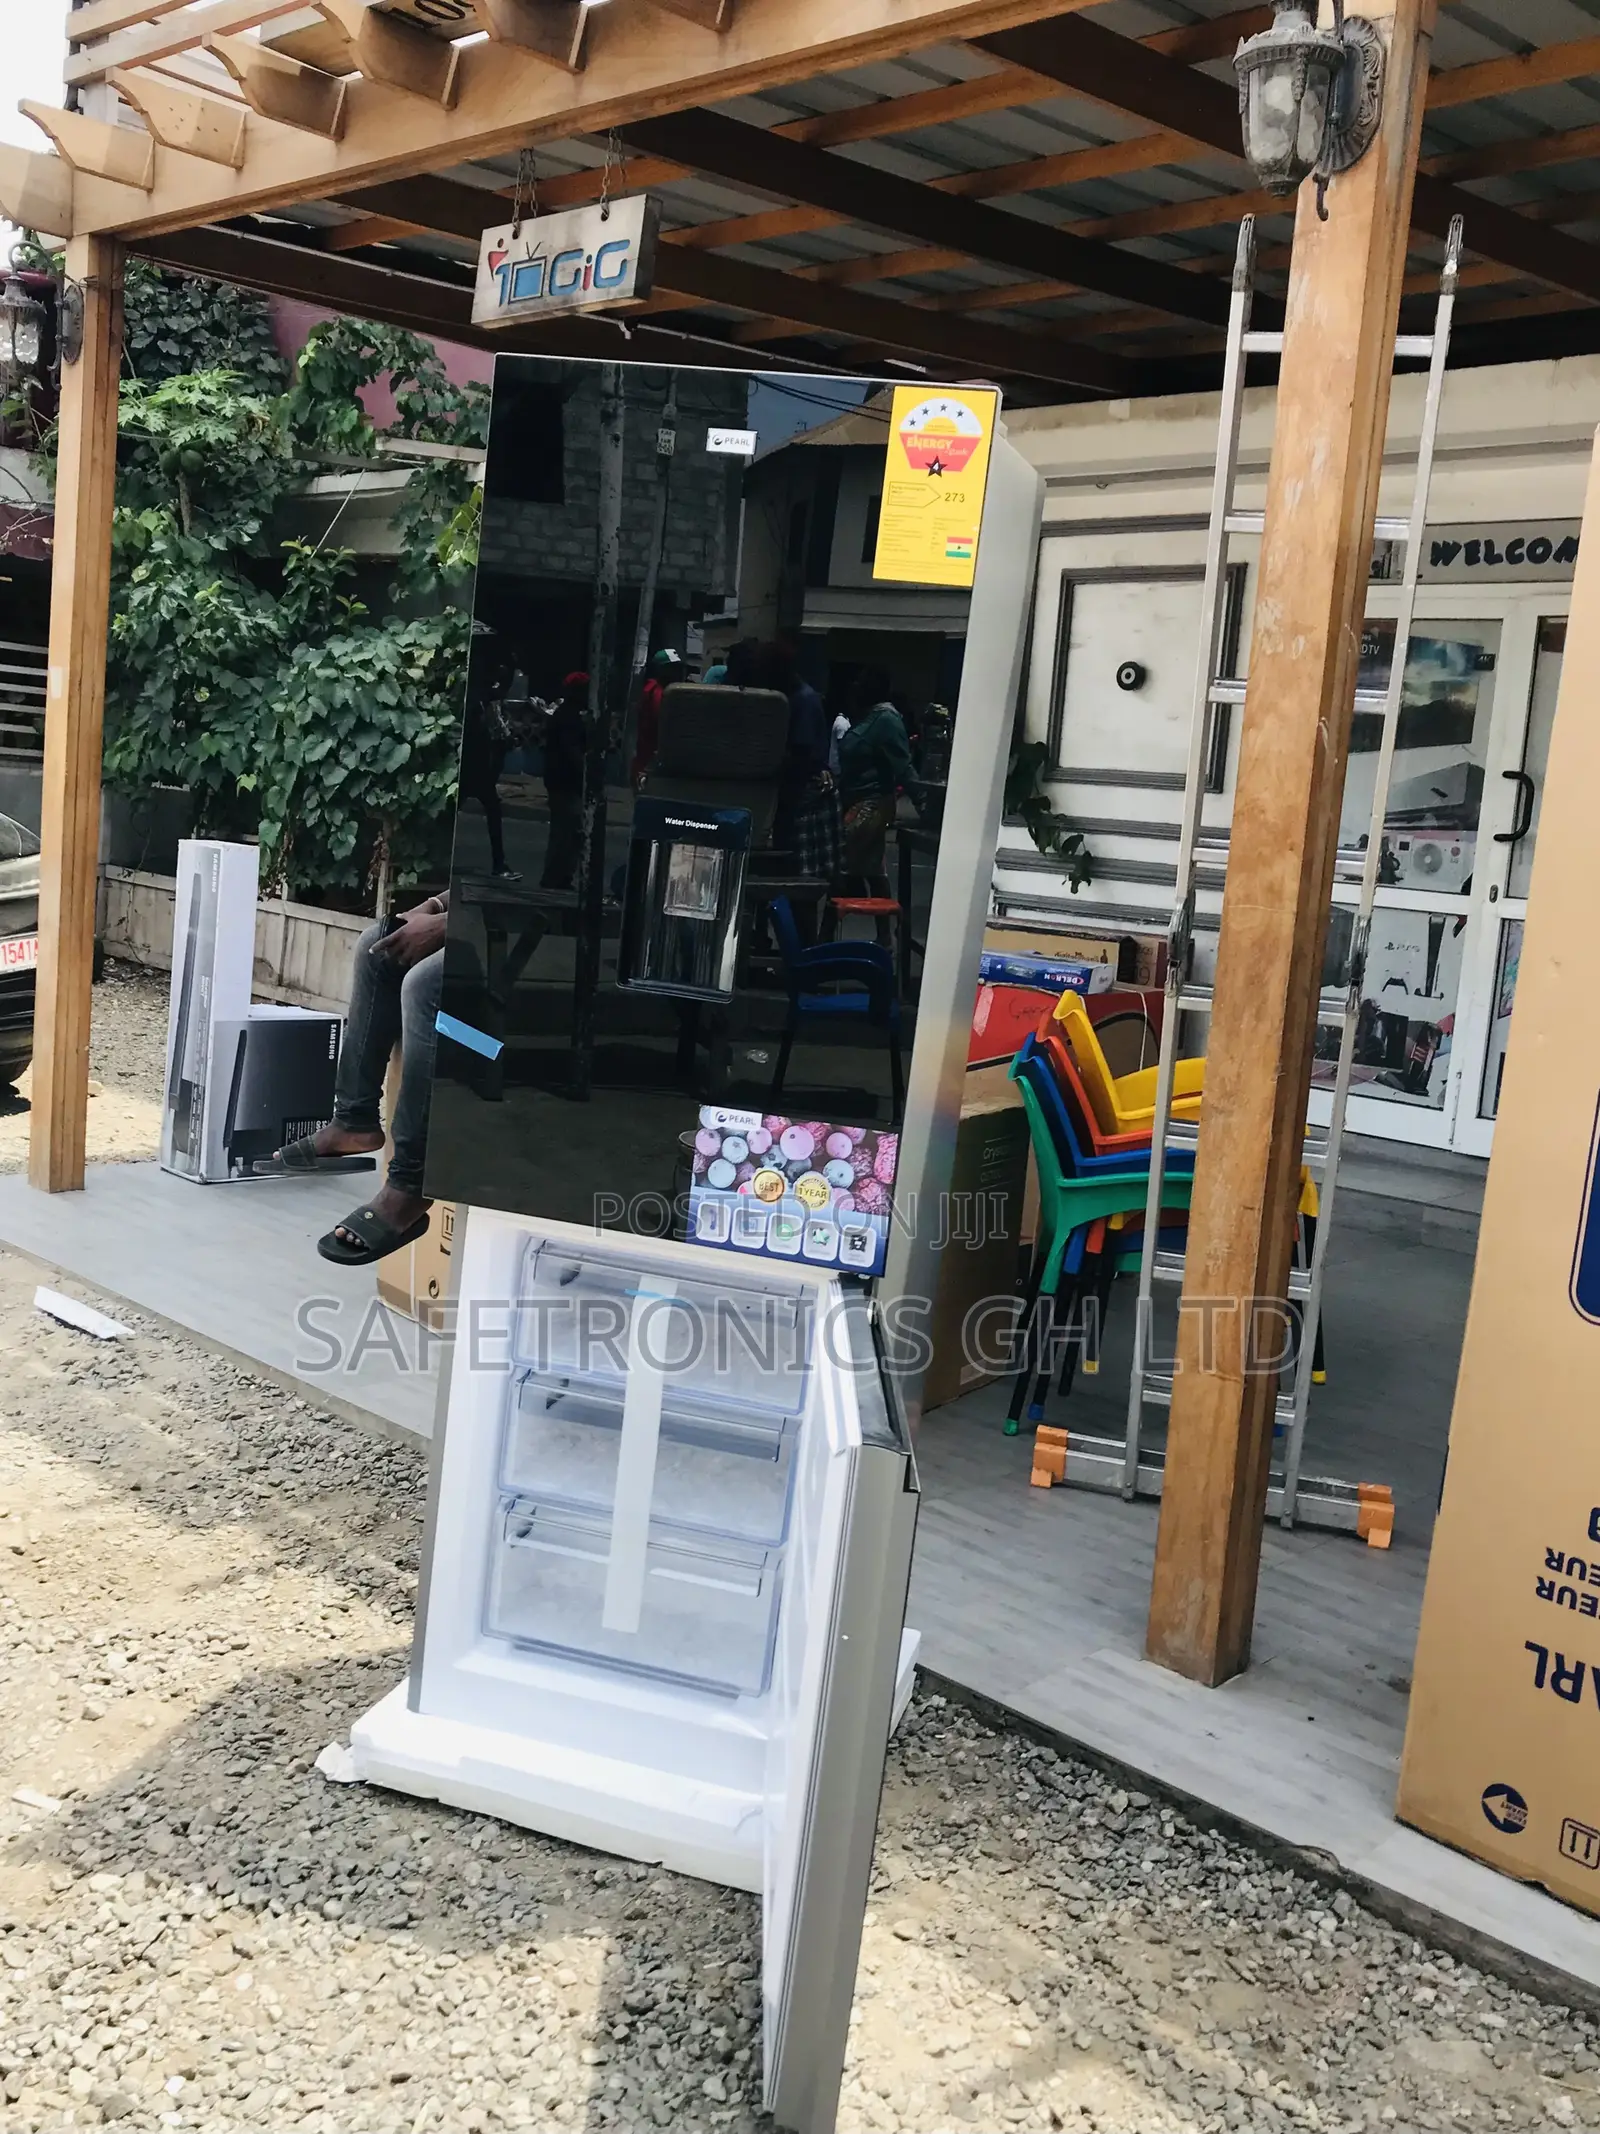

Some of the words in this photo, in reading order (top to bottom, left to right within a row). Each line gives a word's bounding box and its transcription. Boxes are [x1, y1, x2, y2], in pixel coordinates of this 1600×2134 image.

[724, 436, 750, 446] PEARL
[906, 434, 954, 451] ENERGY
[944, 492, 965, 503] 273
[665, 817, 685, 827] Water
[685, 820, 718, 830] Dispenser
[211, 853, 219, 893] SAMSUNG
[328, 1024, 337, 1060] SAMSUNG
[728, 1114, 757, 1126] PEARL
[758, 1179, 780, 1193] BEST
[804, 1187, 827, 1199] YEAR
[1535, 1575, 1600, 1620] EUR
